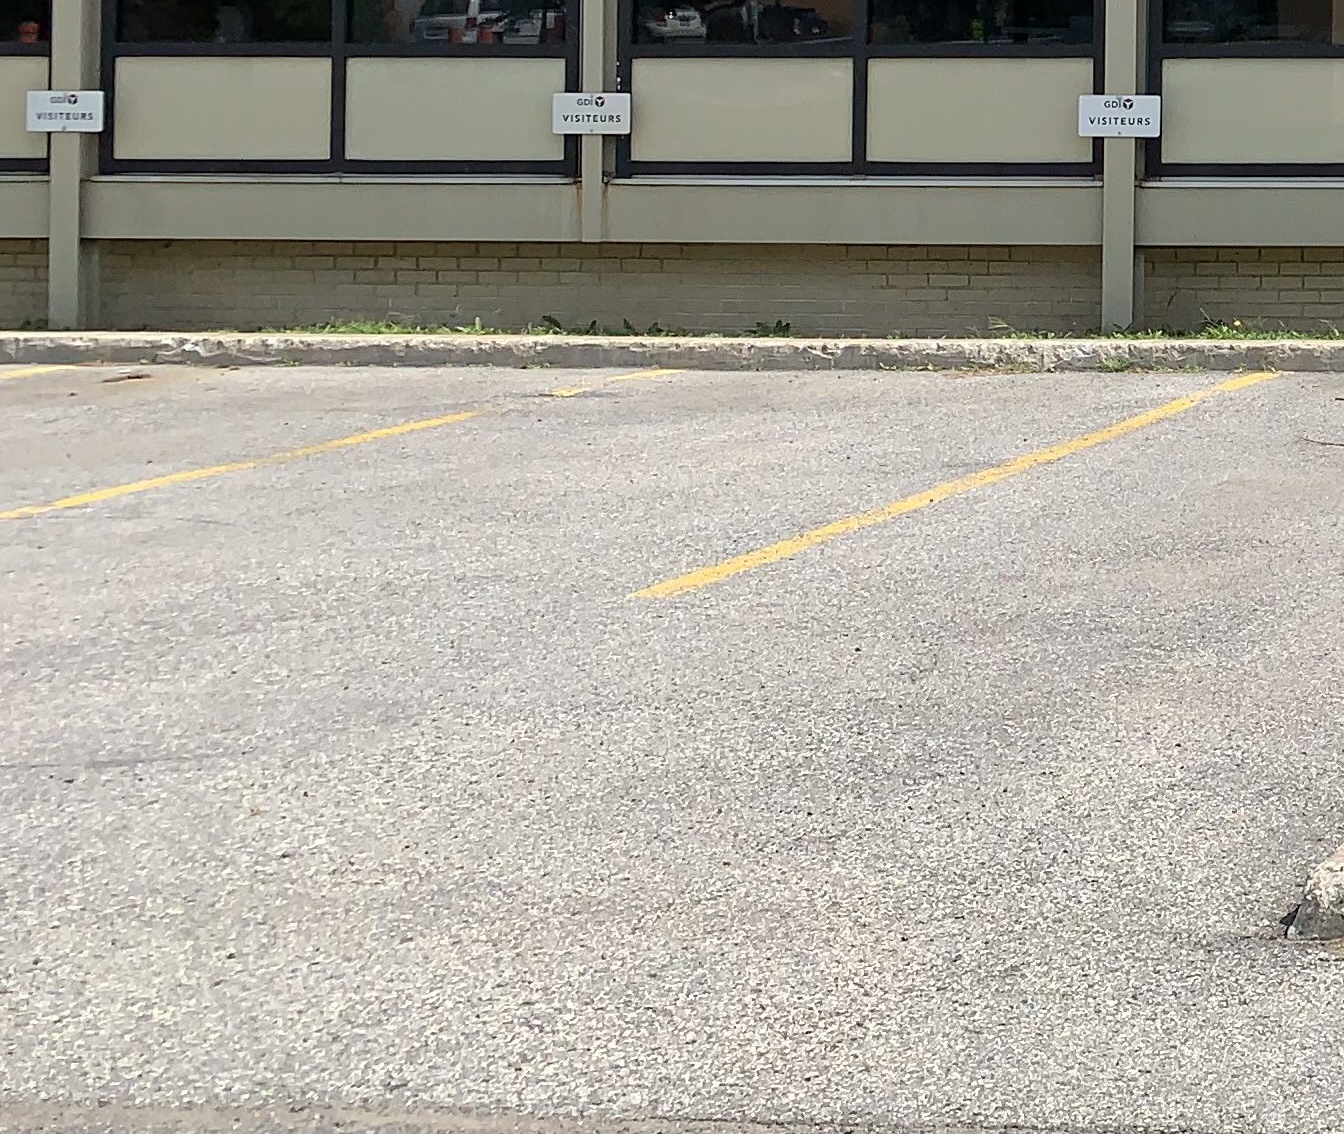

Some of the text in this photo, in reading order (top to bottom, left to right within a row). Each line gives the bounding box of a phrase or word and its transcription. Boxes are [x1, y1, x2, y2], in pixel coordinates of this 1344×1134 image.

[577, 98, 594, 106] GDI
[1103, 99, 1122, 108] GDI
[35, 112, 94, 121] VISITEURS
[562, 114, 621, 123] VISITEURS
[1088, 116, 1151, 126] VISITEURS
